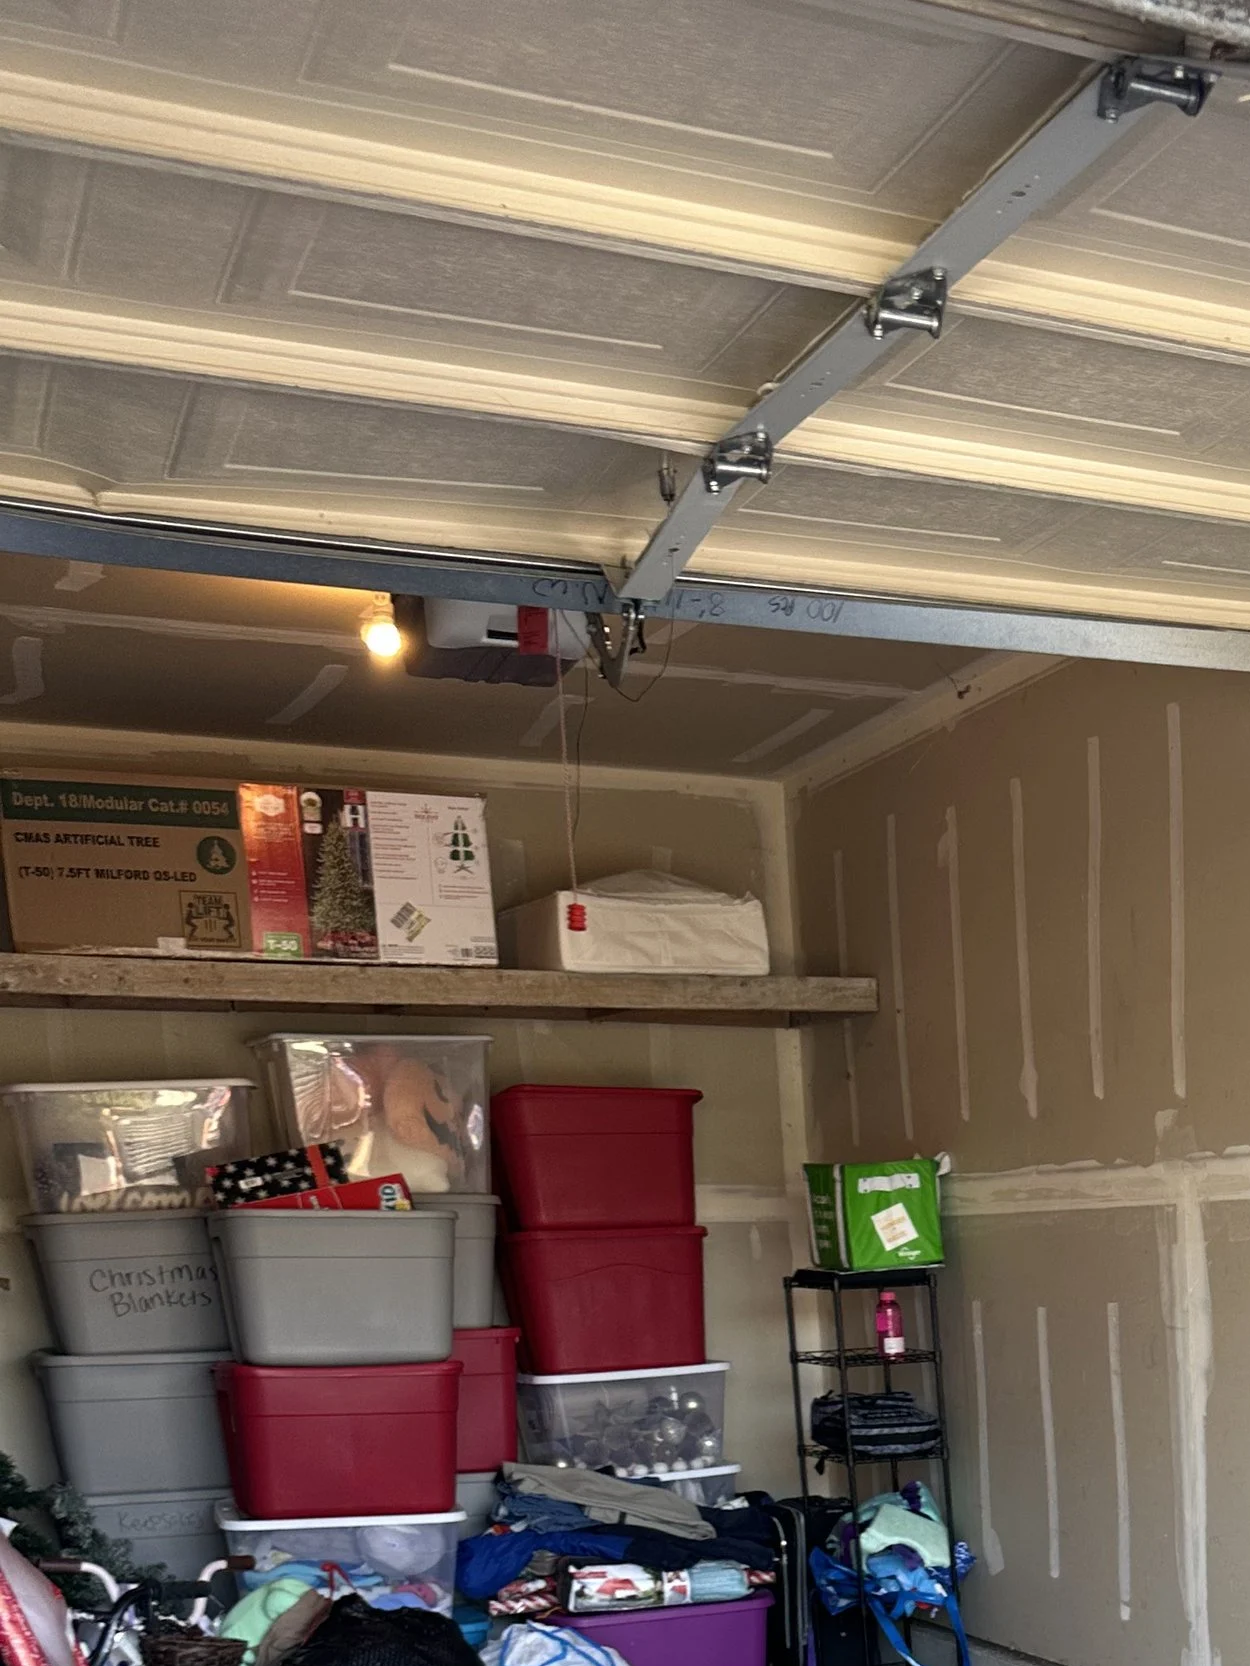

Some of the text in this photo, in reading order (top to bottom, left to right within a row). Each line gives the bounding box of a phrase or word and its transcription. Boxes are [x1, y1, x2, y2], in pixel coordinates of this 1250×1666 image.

[11, 791, 229, 816] Dept. 18/Modular Cat.# 0054
[13, 831, 161, 848] CMAS ARTIFICIAL TREE
[94, 868, 150, 882] MILFORD
[89, 1264, 219, 1293] Christmas
[109, 1289, 213, 1317] Blankets
